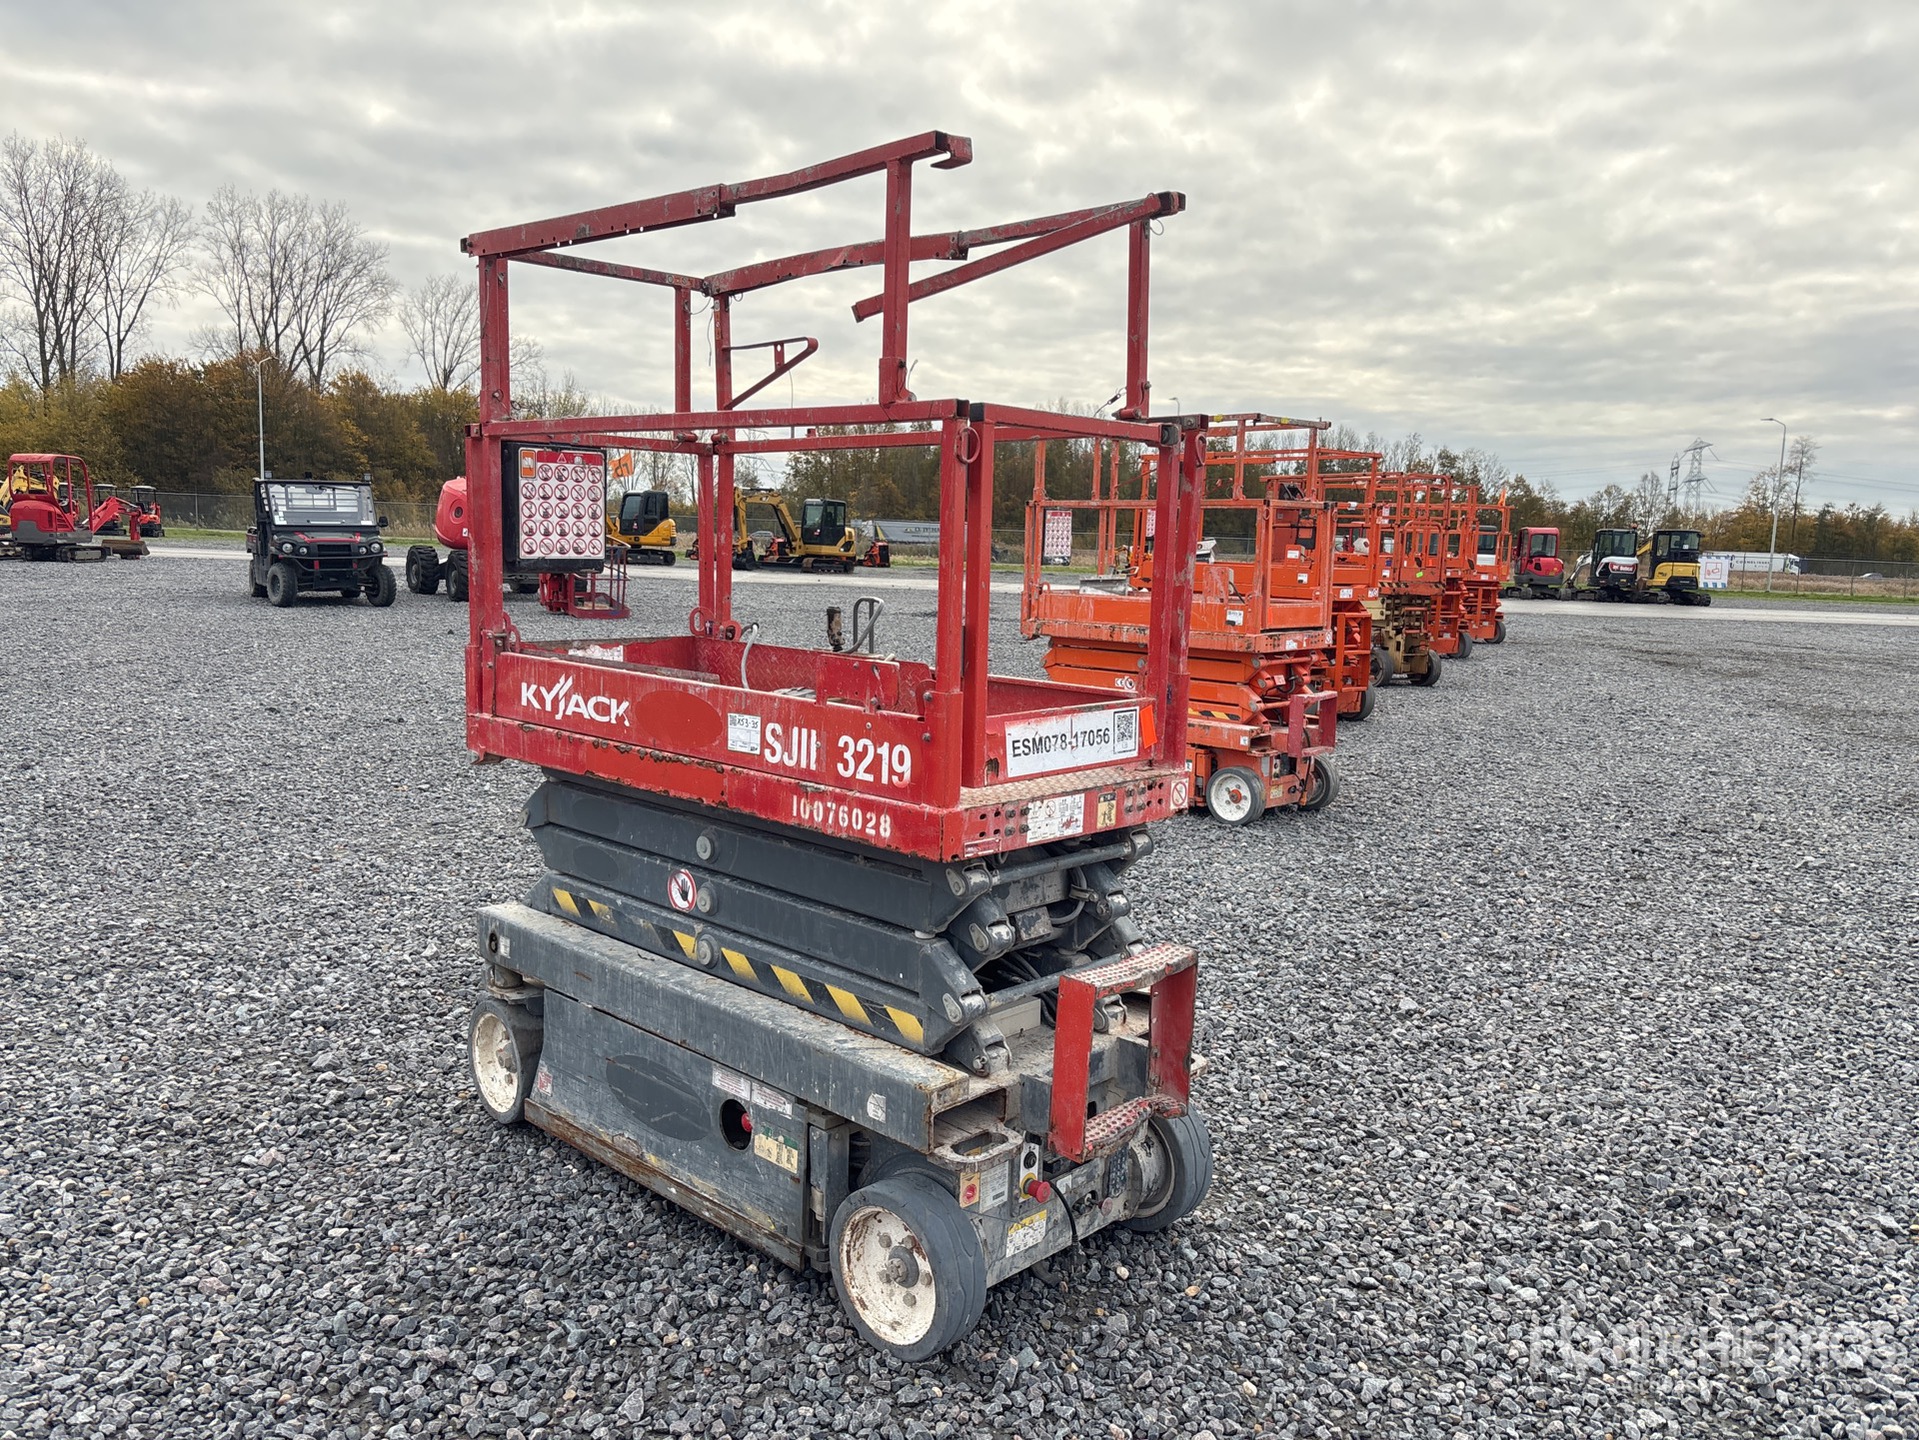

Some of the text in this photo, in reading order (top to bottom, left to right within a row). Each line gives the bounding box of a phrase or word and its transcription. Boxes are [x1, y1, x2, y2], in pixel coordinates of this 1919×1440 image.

[836, 735, 912, 788] 3219
[1012, 727, 1110, 758] ESM078-17056
[792, 795, 891, 838] 10076028
